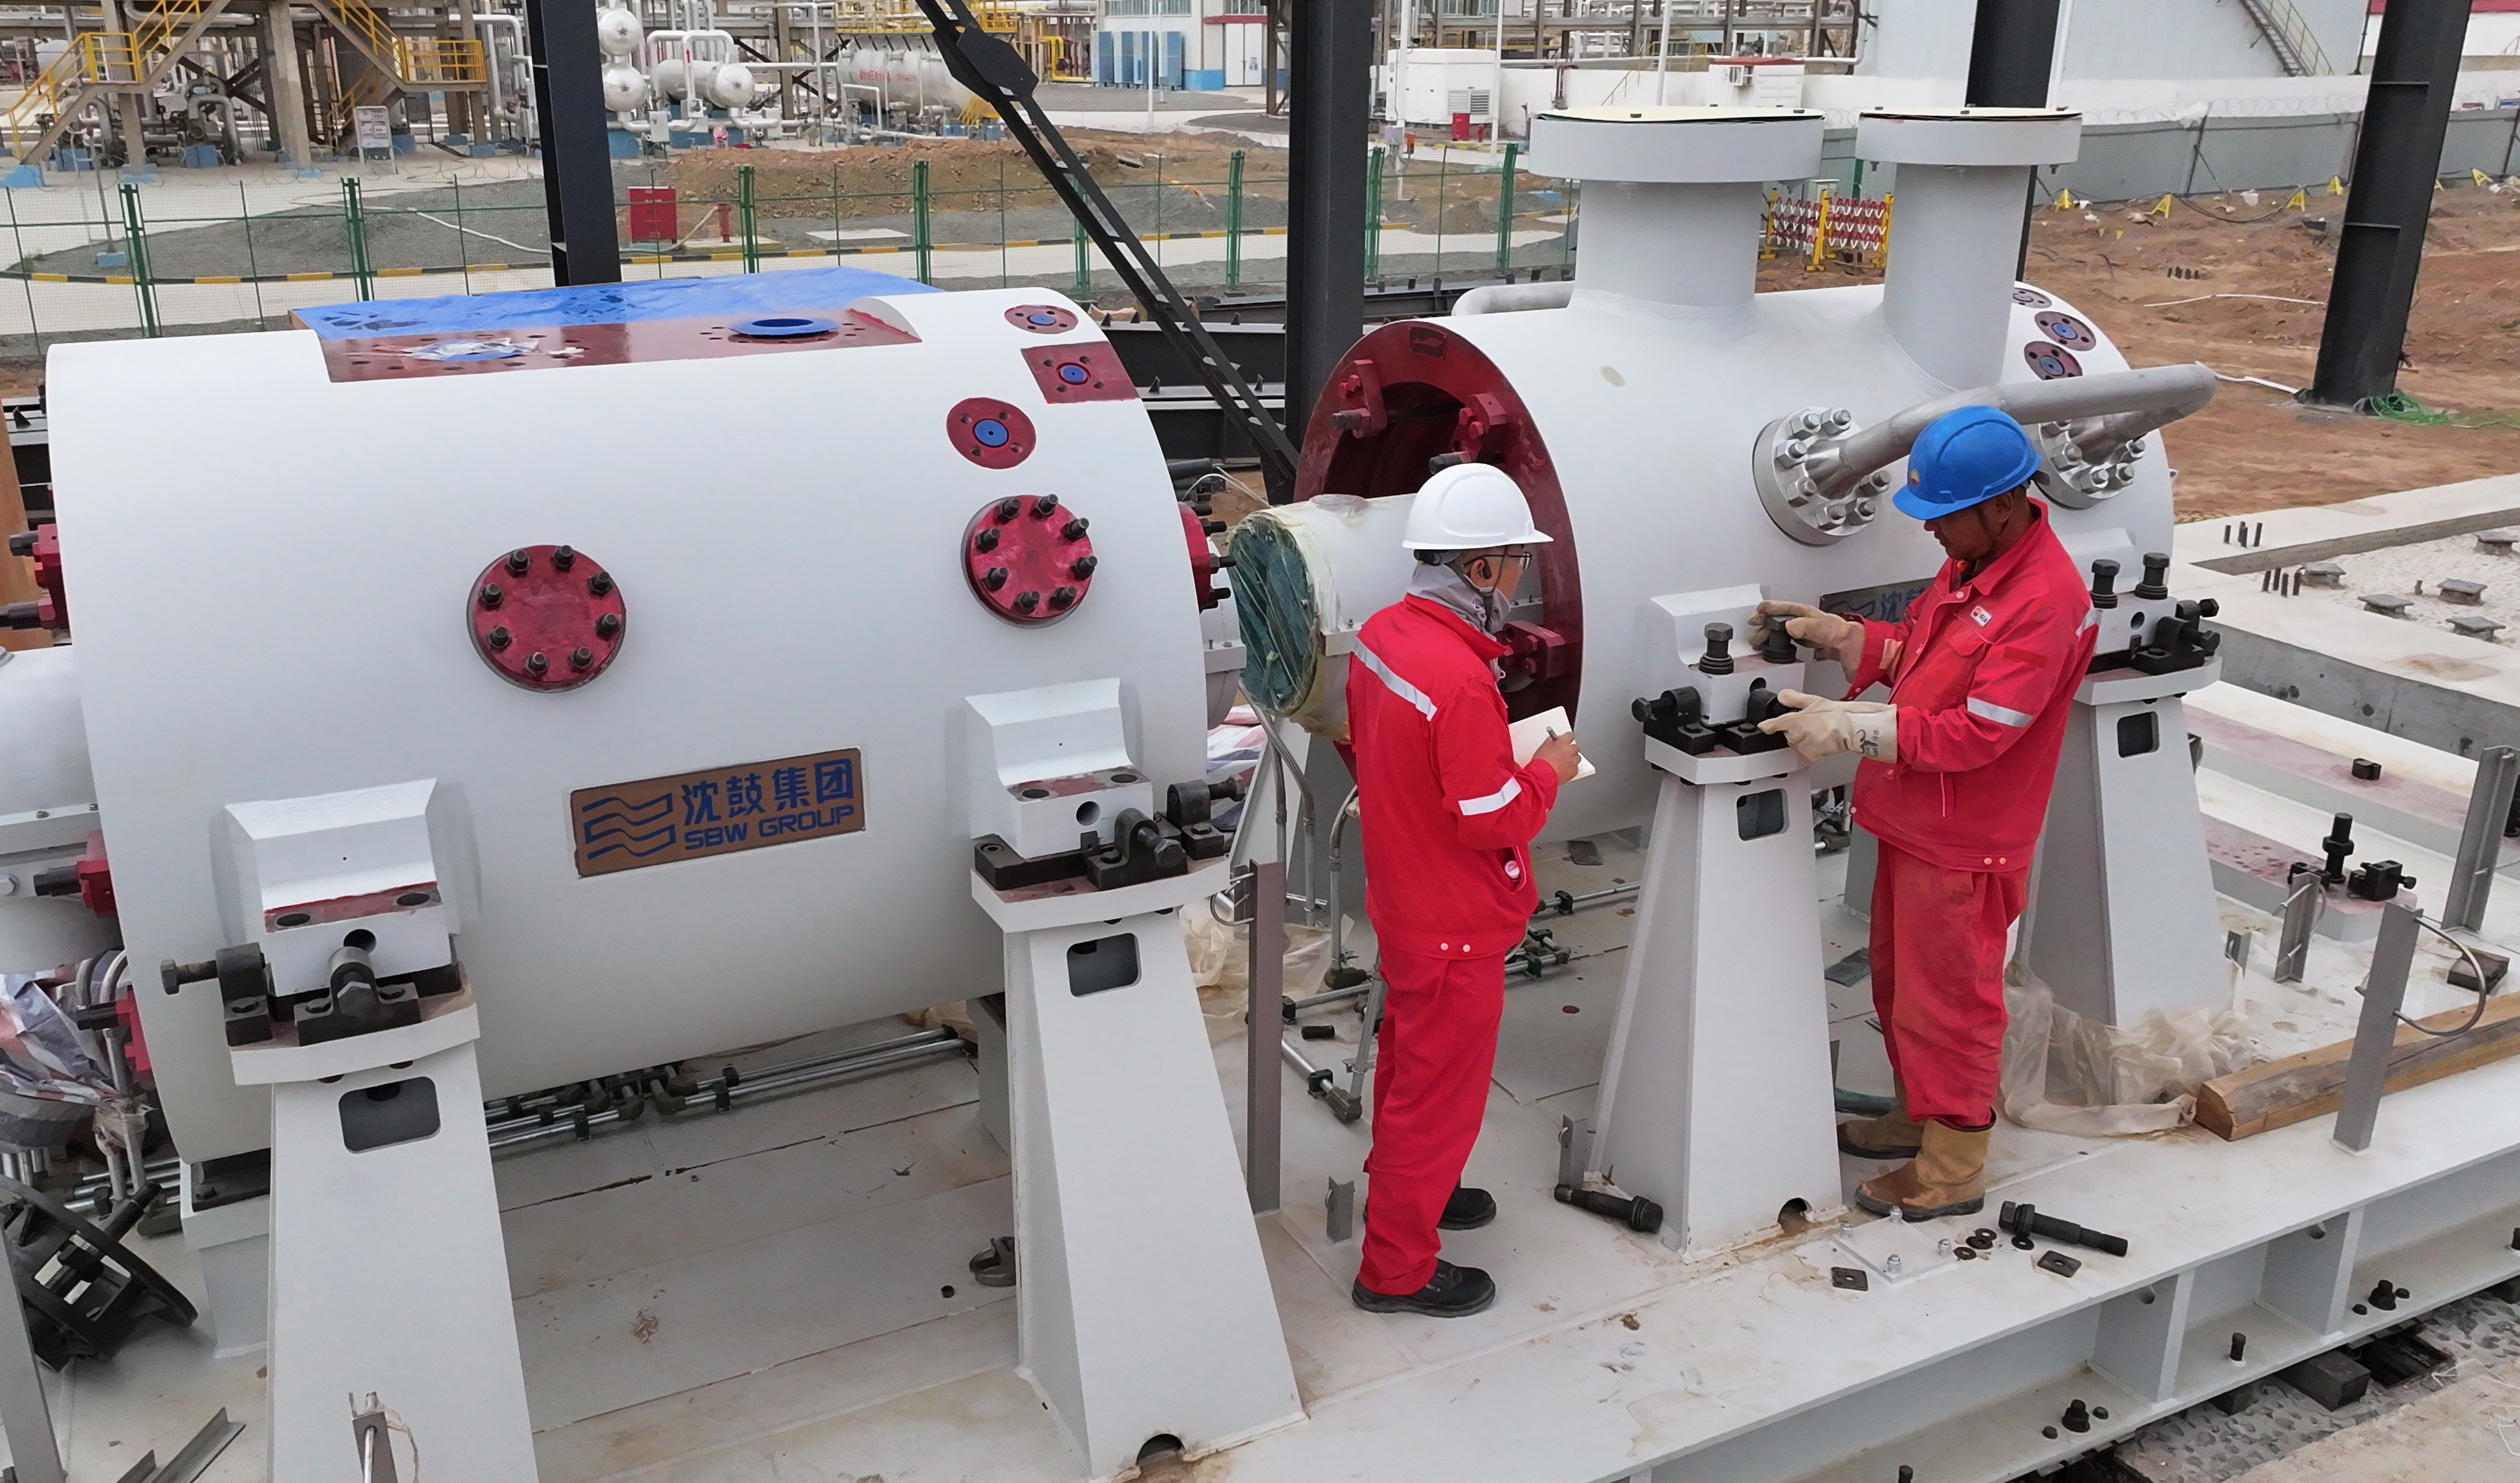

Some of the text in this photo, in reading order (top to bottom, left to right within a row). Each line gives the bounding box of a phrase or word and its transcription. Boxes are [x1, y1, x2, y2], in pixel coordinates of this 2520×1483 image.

[680, 758, 854, 825] 沈鼓集团
[684, 806, 854, 850] SBW GROUP
